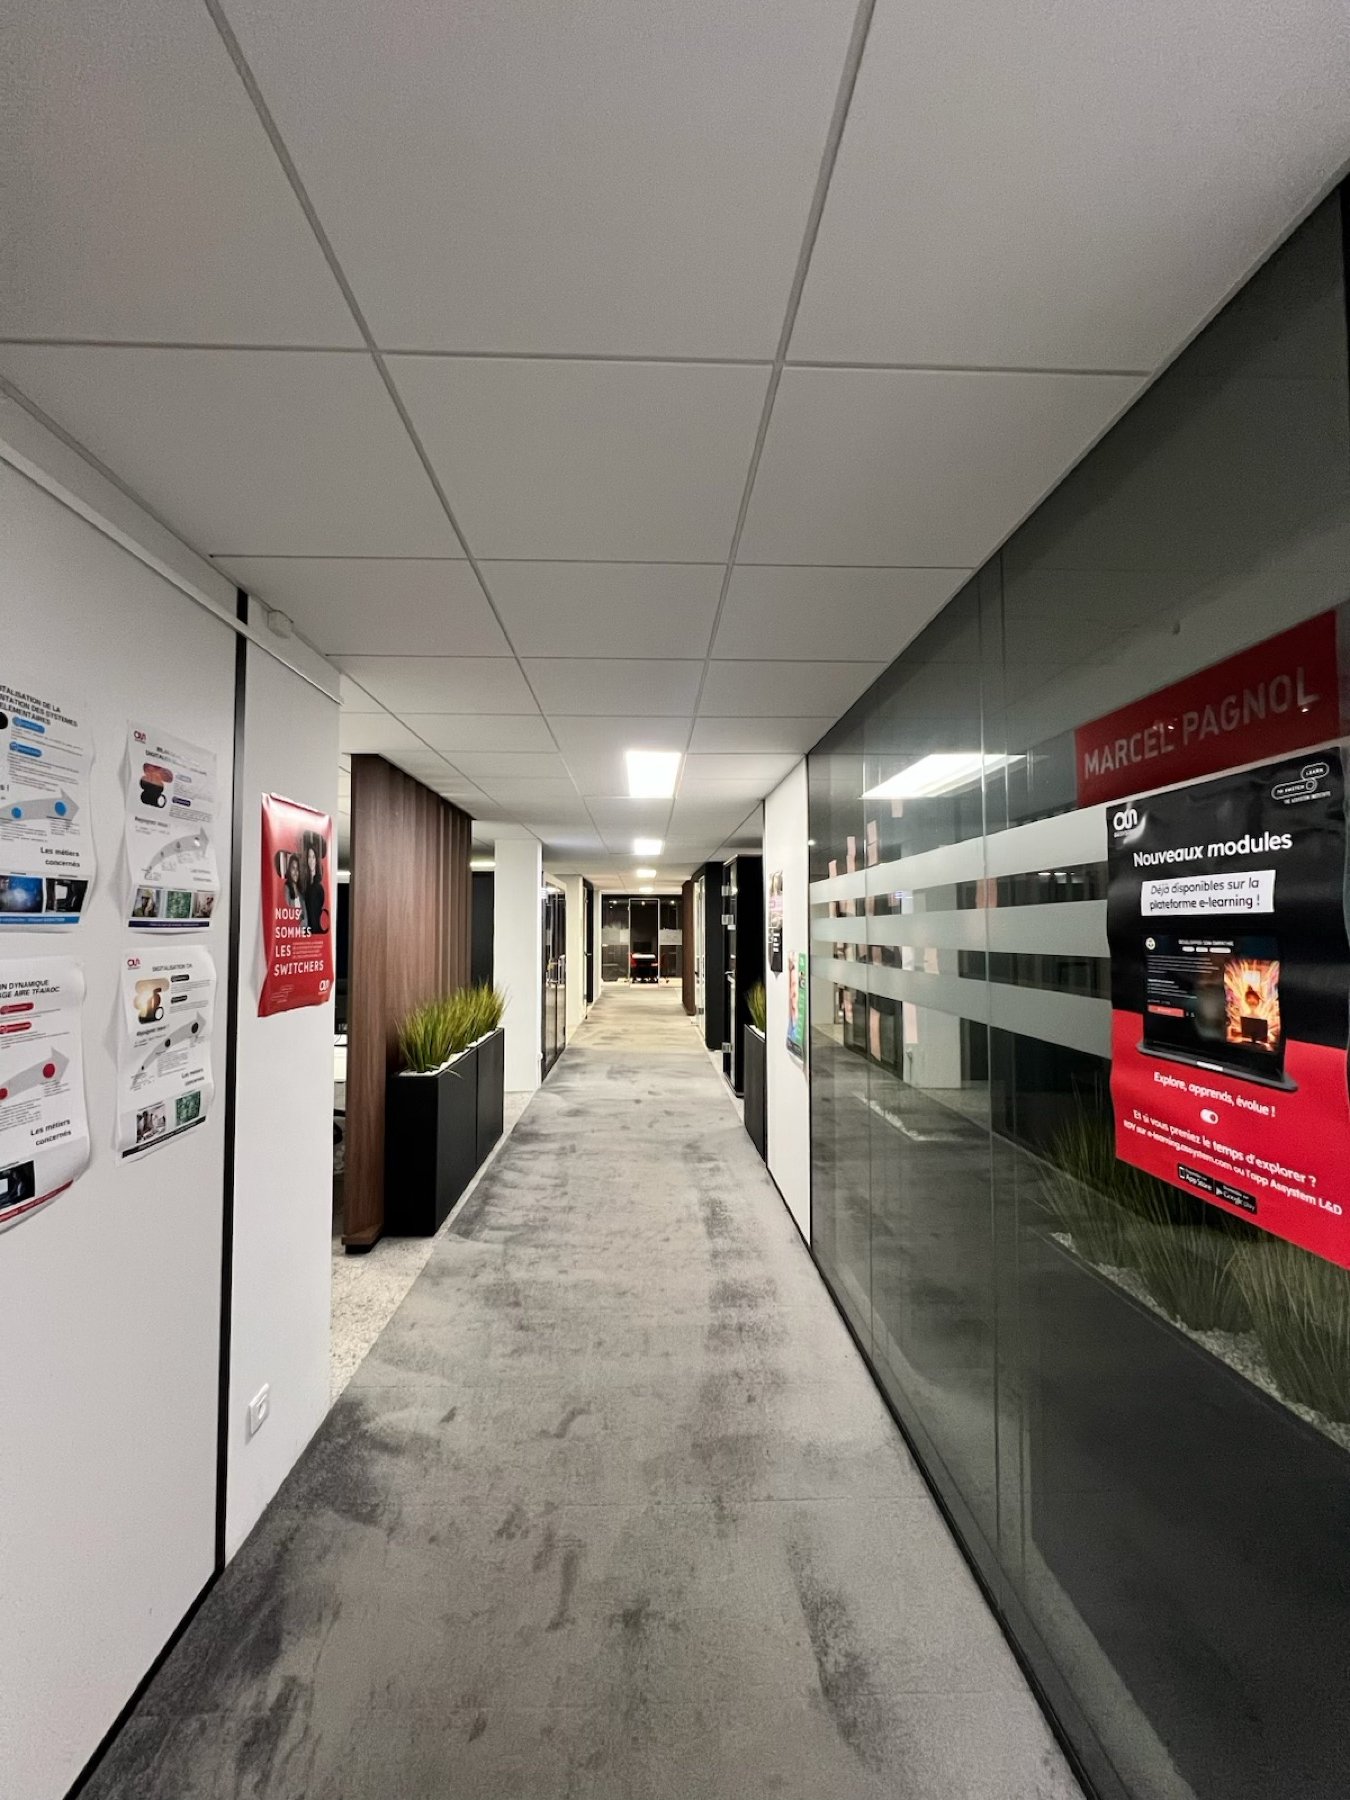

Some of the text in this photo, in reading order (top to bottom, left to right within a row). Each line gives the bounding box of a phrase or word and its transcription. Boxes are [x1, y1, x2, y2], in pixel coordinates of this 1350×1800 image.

[31, 704, 44, 715] DES
[42, 701, 51, 710] DE
[52, 704, 61, 713] LA
[1084, 667, 1320, 779] MARCEL PAGNOL
[1133, 831, 1293, 867] Nouveaux modules
[1171, 877, 1225, 895] disponibles
[1227, 879, 1244, 890] sur
[1248, 877, 1259, 889] la
[1150, 897, 1197, 911] plateforme
[1200, 896, 1253, 909] e-learning
[275, 908, 302, 920] NOUS
[275, 926, 312, 938] SOMMES
[275, 944, 291, 958] LES
[273, 960, 324, 977] SWITCHERS
[8, 979, 49, 989] DYNAMIQUE
[1153, 1071, 1187, 1092] Explore,
[1188, 1083, 1235, 1107] apprends,
[1236, 1095, 1269, 1116] évolue
[30, 1118, 71, 1136] Les métiers
[35, 1130, 72, 1146] concernés
[1133, 1109, 1317, 1188] Et si vous preniez le temps d'explorer ?
[1233, 1166, 1245, 1176] ou
[1270, 1178, 1316, 1206] Assystem
[1318, 1197, 1343, 1216] L&D
